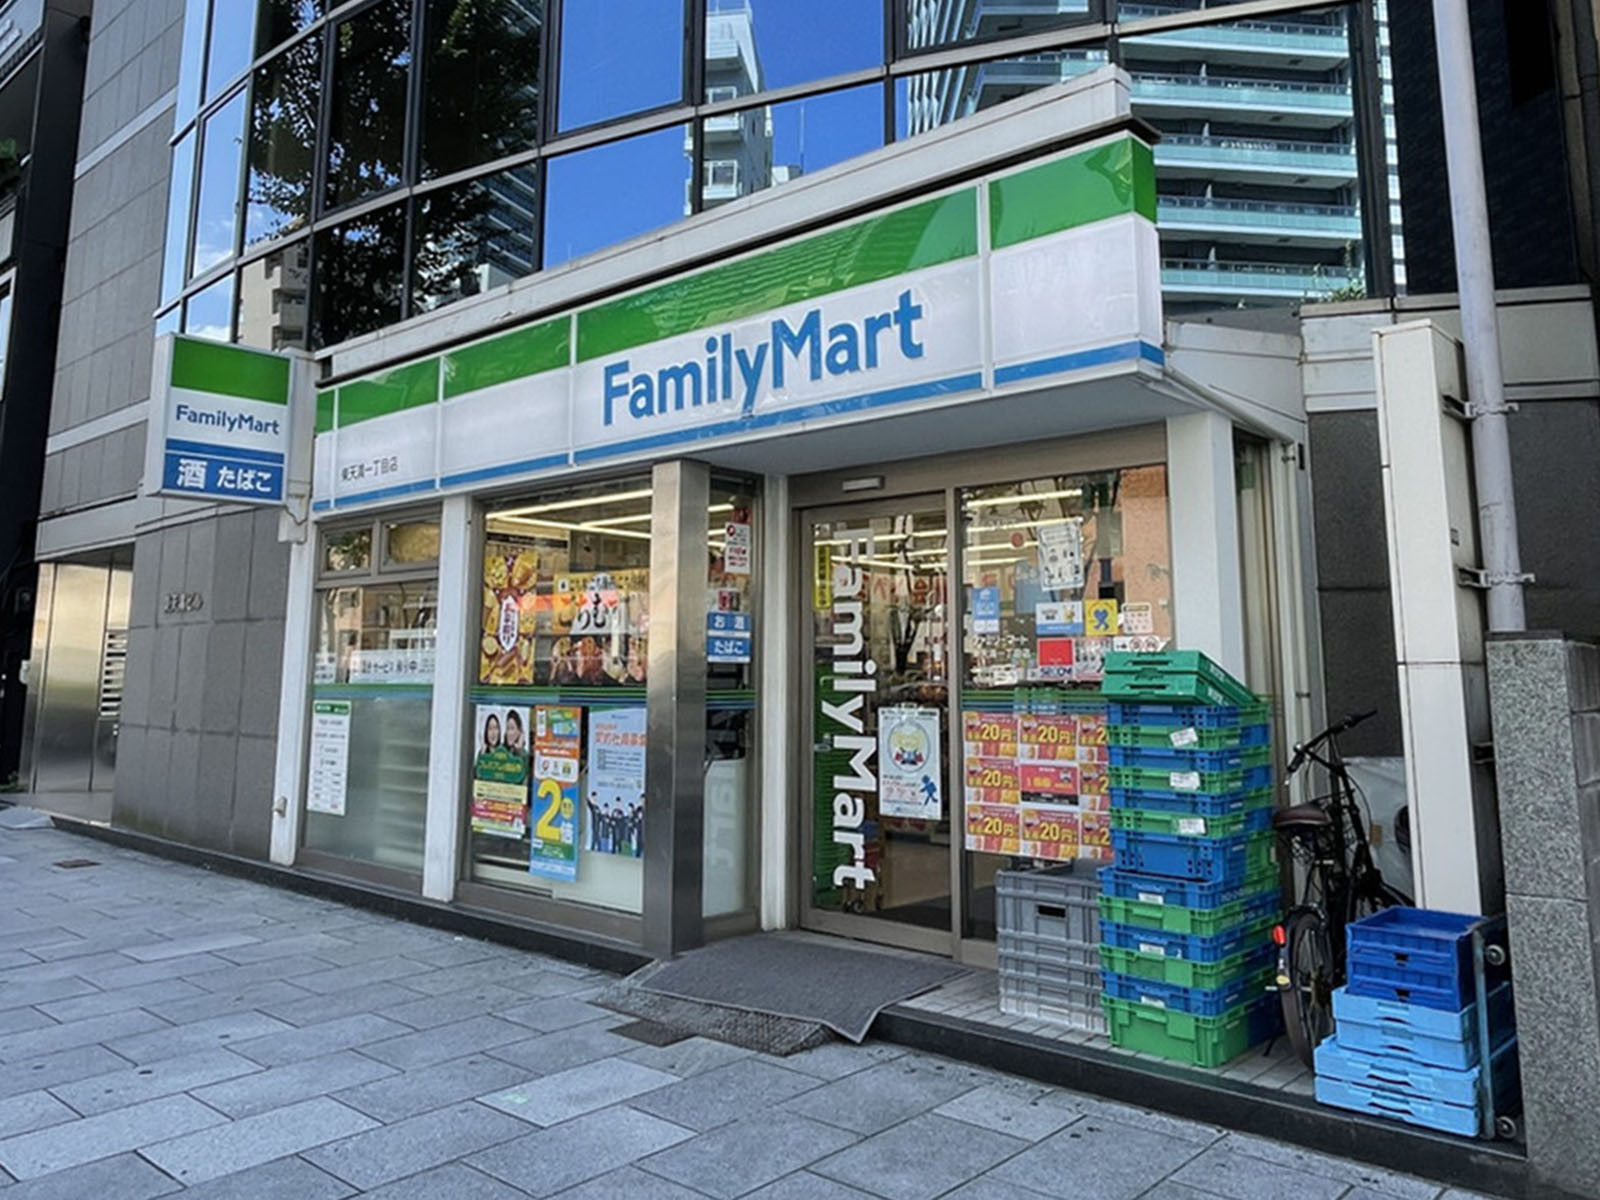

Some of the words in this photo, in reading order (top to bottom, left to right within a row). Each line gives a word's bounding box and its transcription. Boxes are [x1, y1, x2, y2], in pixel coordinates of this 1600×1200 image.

[604, 289, 923, 426] FamilyMart
[176, 404, 280, 435] FamilyMart
[178, 458, 208, 490] 酒
[217, 465, 272, 492] たばこ
[714, 640, 745, 655] たばこ
[821, 528, 877, 889] FamilyMart
